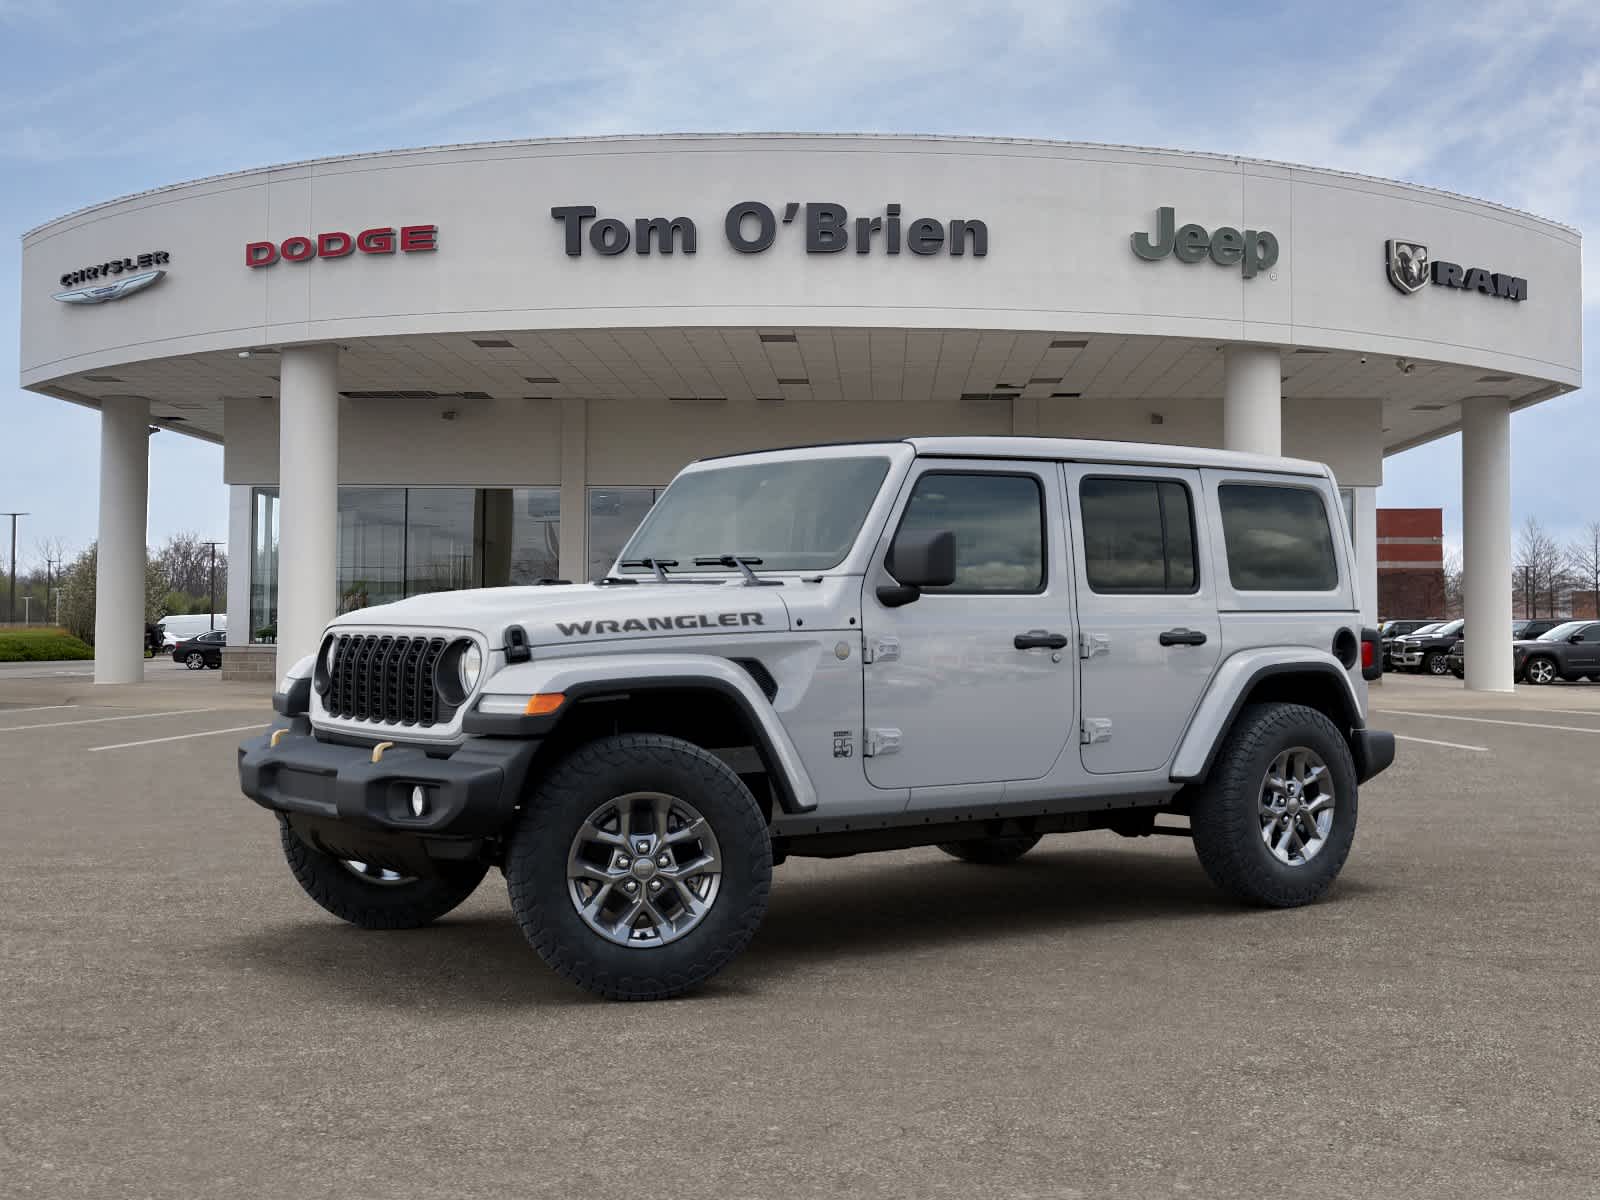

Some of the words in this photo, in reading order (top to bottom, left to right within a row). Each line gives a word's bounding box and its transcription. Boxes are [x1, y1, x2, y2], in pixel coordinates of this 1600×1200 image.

[246, 225, 438, 268] DODGE
[551, 205, 697, 256] Tom
[725, 201, 988, 256] O'Brien
[1131, 206, 1279, 279] Jeep
[60, 251, 169, 287] CHRYSLER
[1431, 260, 1527, 301] RAM
[555, 612, 765, 637] WRANGLER
